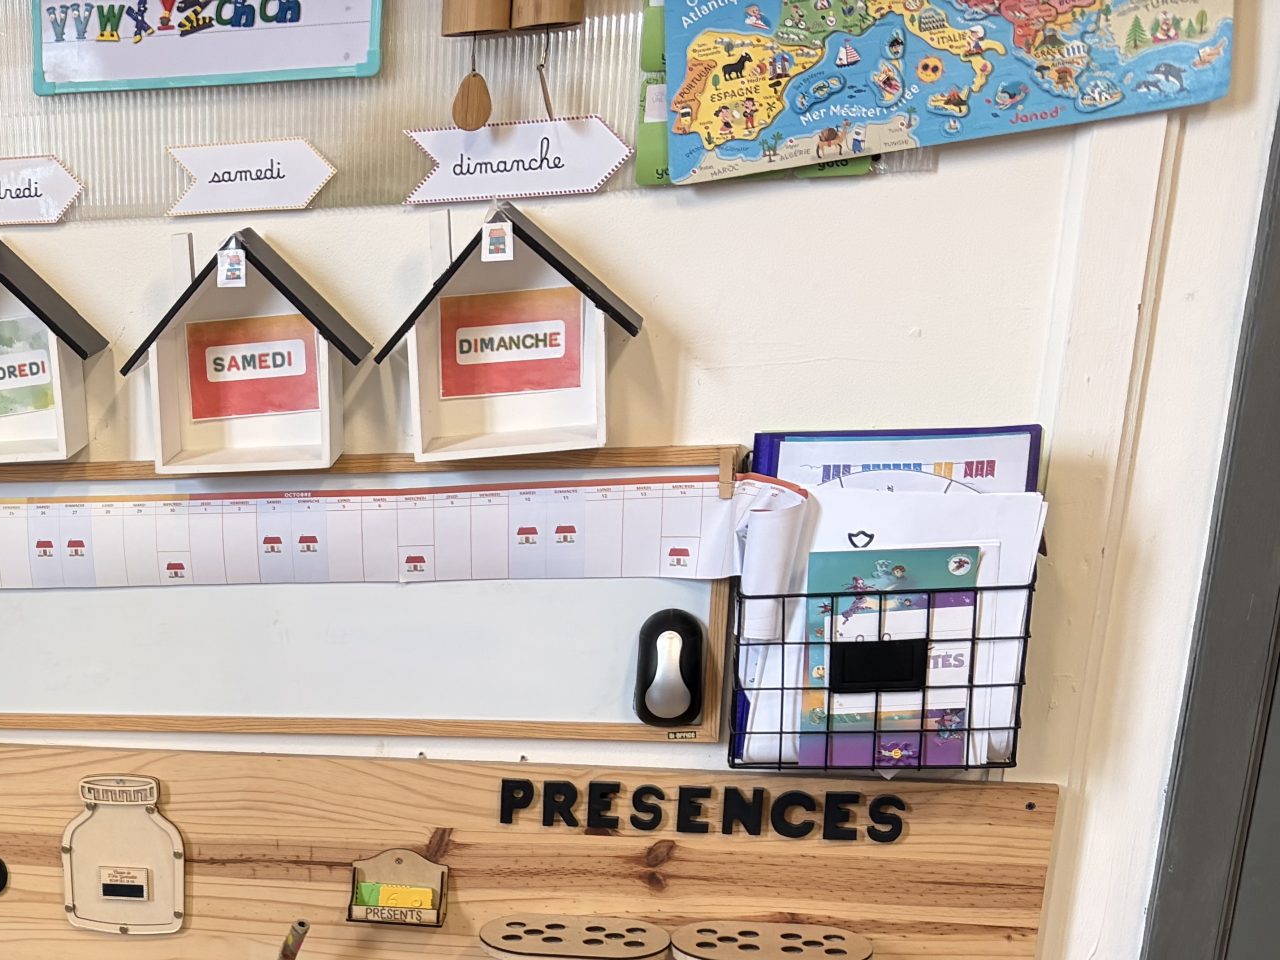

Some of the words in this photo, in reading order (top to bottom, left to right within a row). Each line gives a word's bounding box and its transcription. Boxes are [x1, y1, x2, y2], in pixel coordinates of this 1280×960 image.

[710, 85, 761, 102] ESPAGNE
[799, 109, 827, 126] Mer
[452, 136, 565, 176] dimanche
[780, 148, 812, 161] ALGÉRIE
[208, 158, 286, 183] samedi
[710, 163, 739, 178] MAROC
[458, 332, 562, 354] DIMANCHE
[212, 351, 293, 372] SAMEDI
[500, 778, 907, 843] PRESENCES
